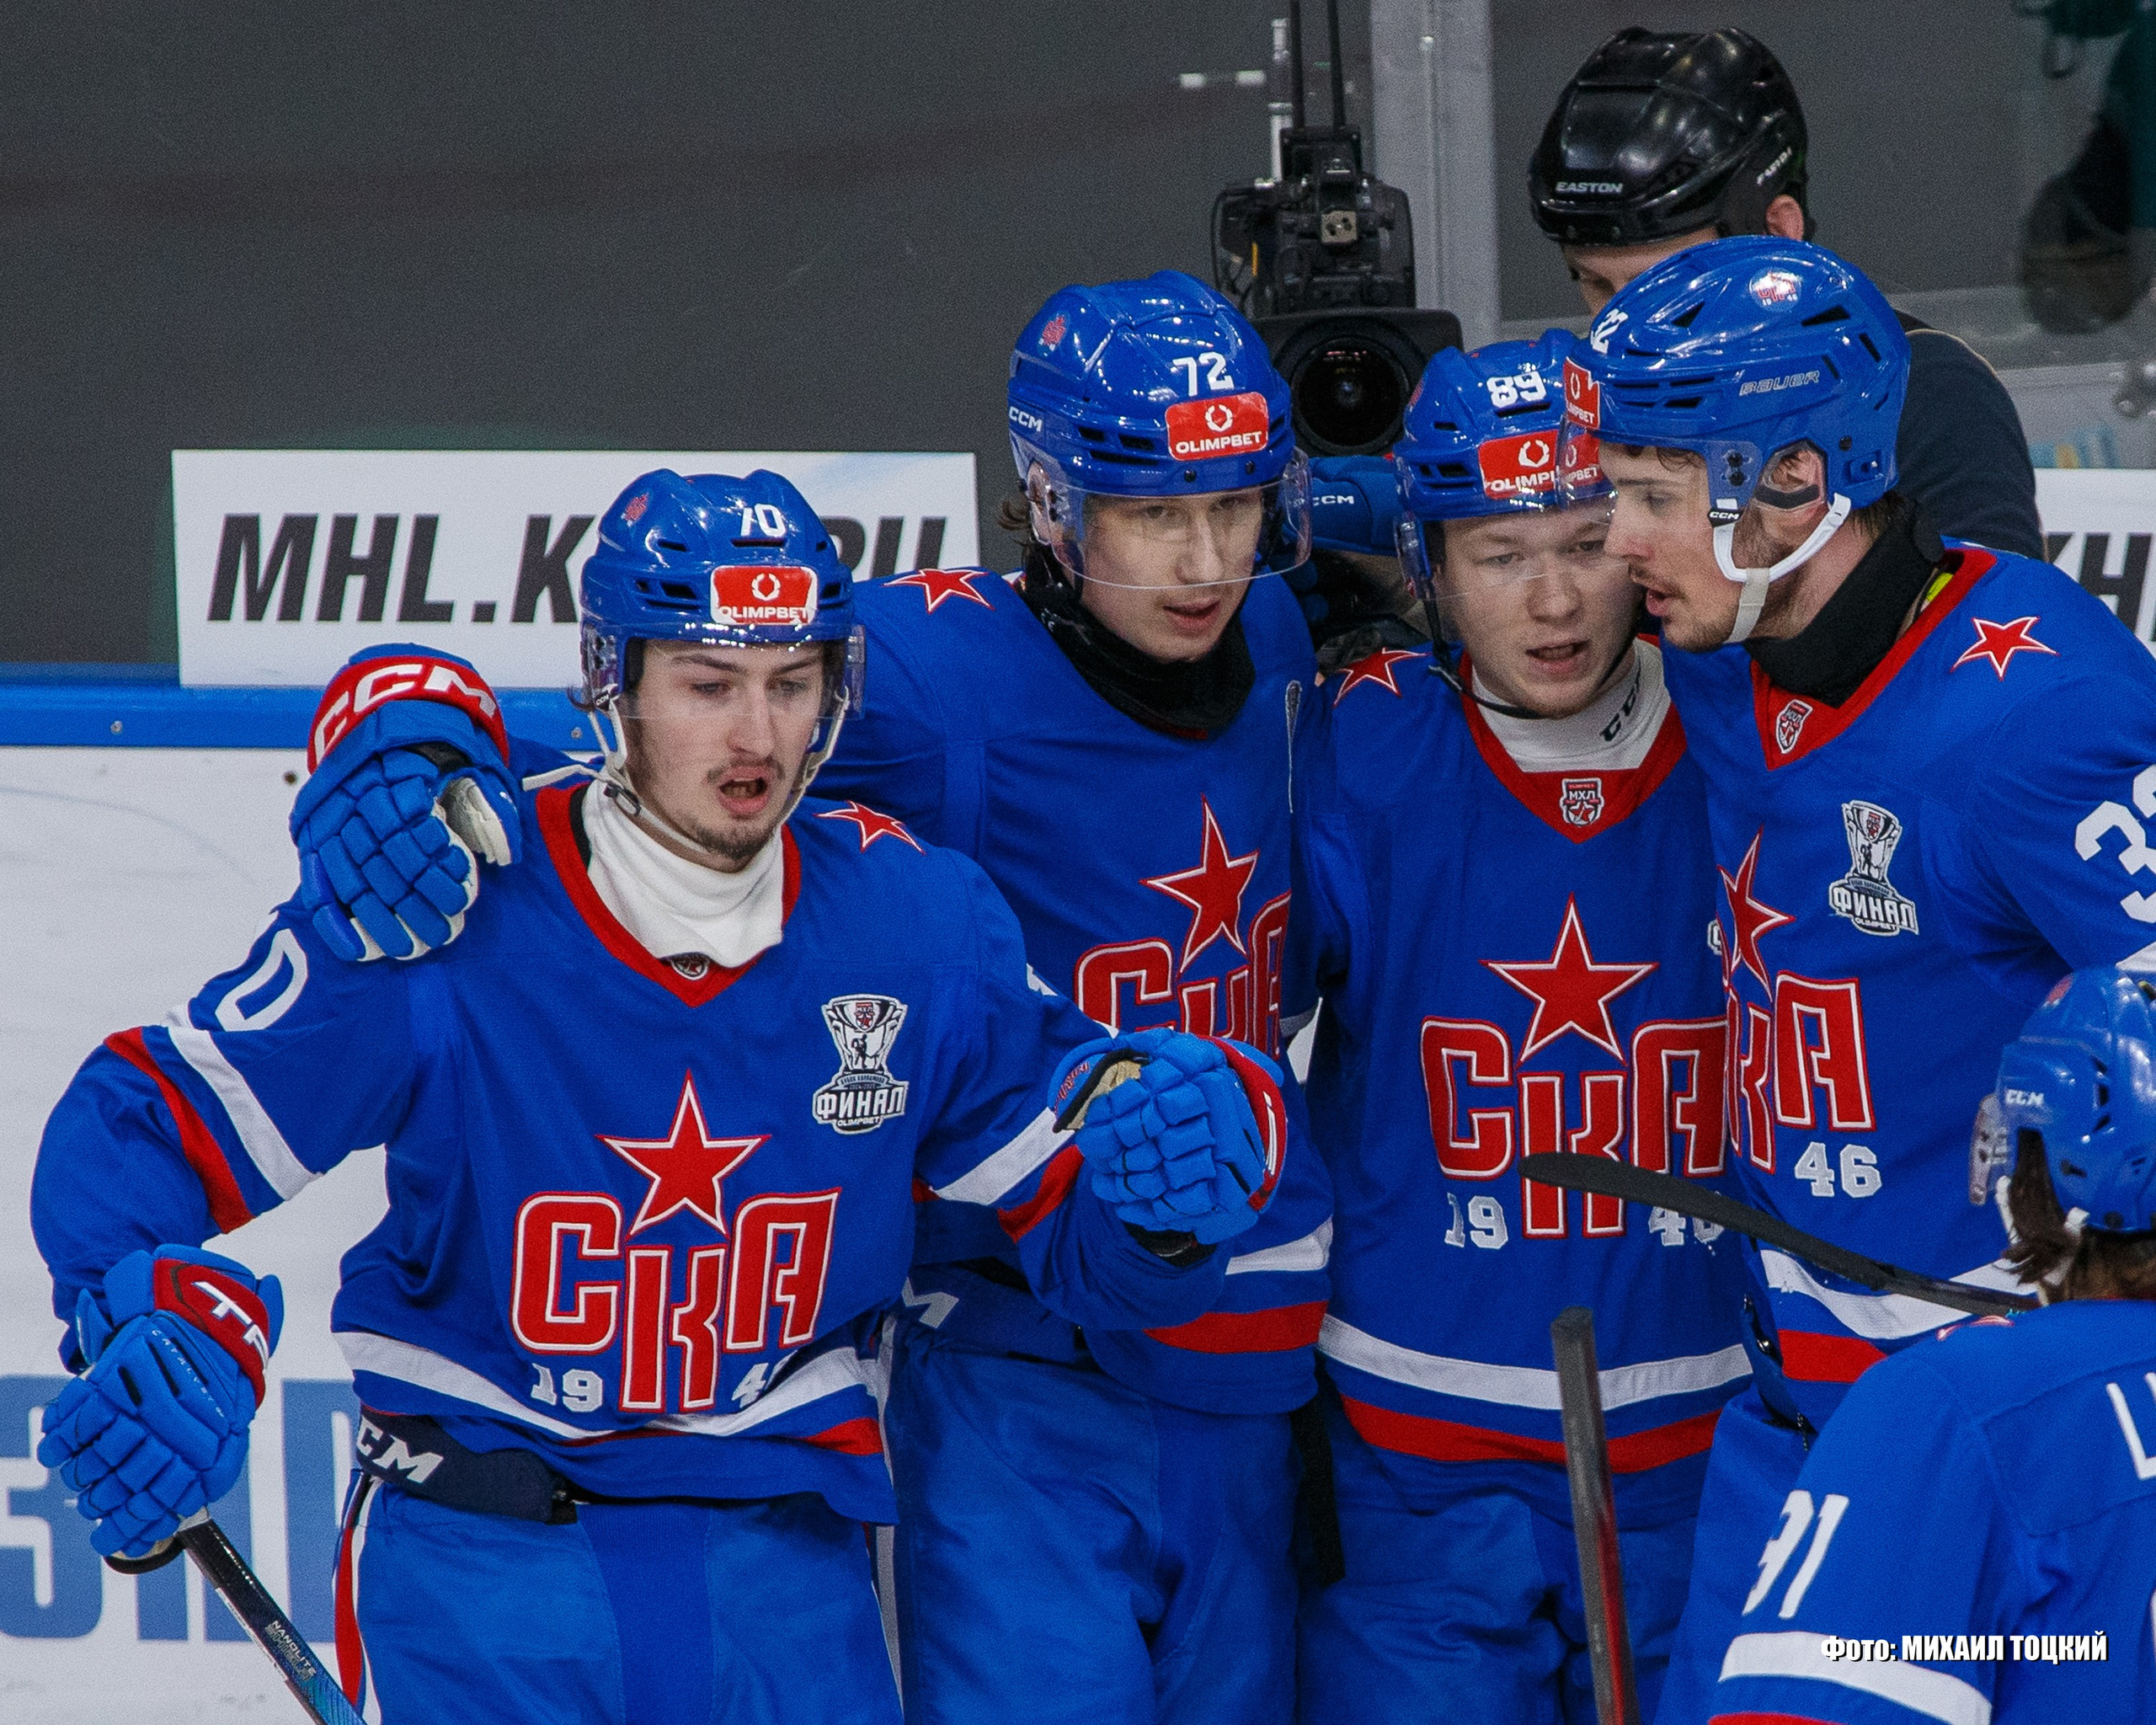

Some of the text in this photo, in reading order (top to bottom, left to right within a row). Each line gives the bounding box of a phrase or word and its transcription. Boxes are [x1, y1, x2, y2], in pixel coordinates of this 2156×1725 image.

[1555, 181, 1624, 195] EASTON
[1171, 350, 1235, 398] 72
[1486, 370, 1548, 409] 89
[1737, 369, 1821, 397] BAUER
[1008, 405, 1043, 432] CCM
[1175, 430, 1263, 455] OLIMPBET
[1708, 510, 1740, 521] CCM
[718, 606, 810, 620] OLIMPBET
[312, 663, 499, 766] CCM
[1569, 790, 1596, 800] МХЛ
[1833, 886, 1916, 929] ФИНАЛ
[816, 1086, 905, 1119] ФИНАЛ
[2004, 1088, 2045, 1106] CCM
[1419, 1015, 1728, 1240] СКА
[1794, 1140, 1883, 1199] 46
[1444, 1191, 1508, 1249] 19
[510, 1186, 843, 1414] СКА
[530, 1362, 604, 1413] 19
[272, 1620, 317, 1677] NANOLITE
